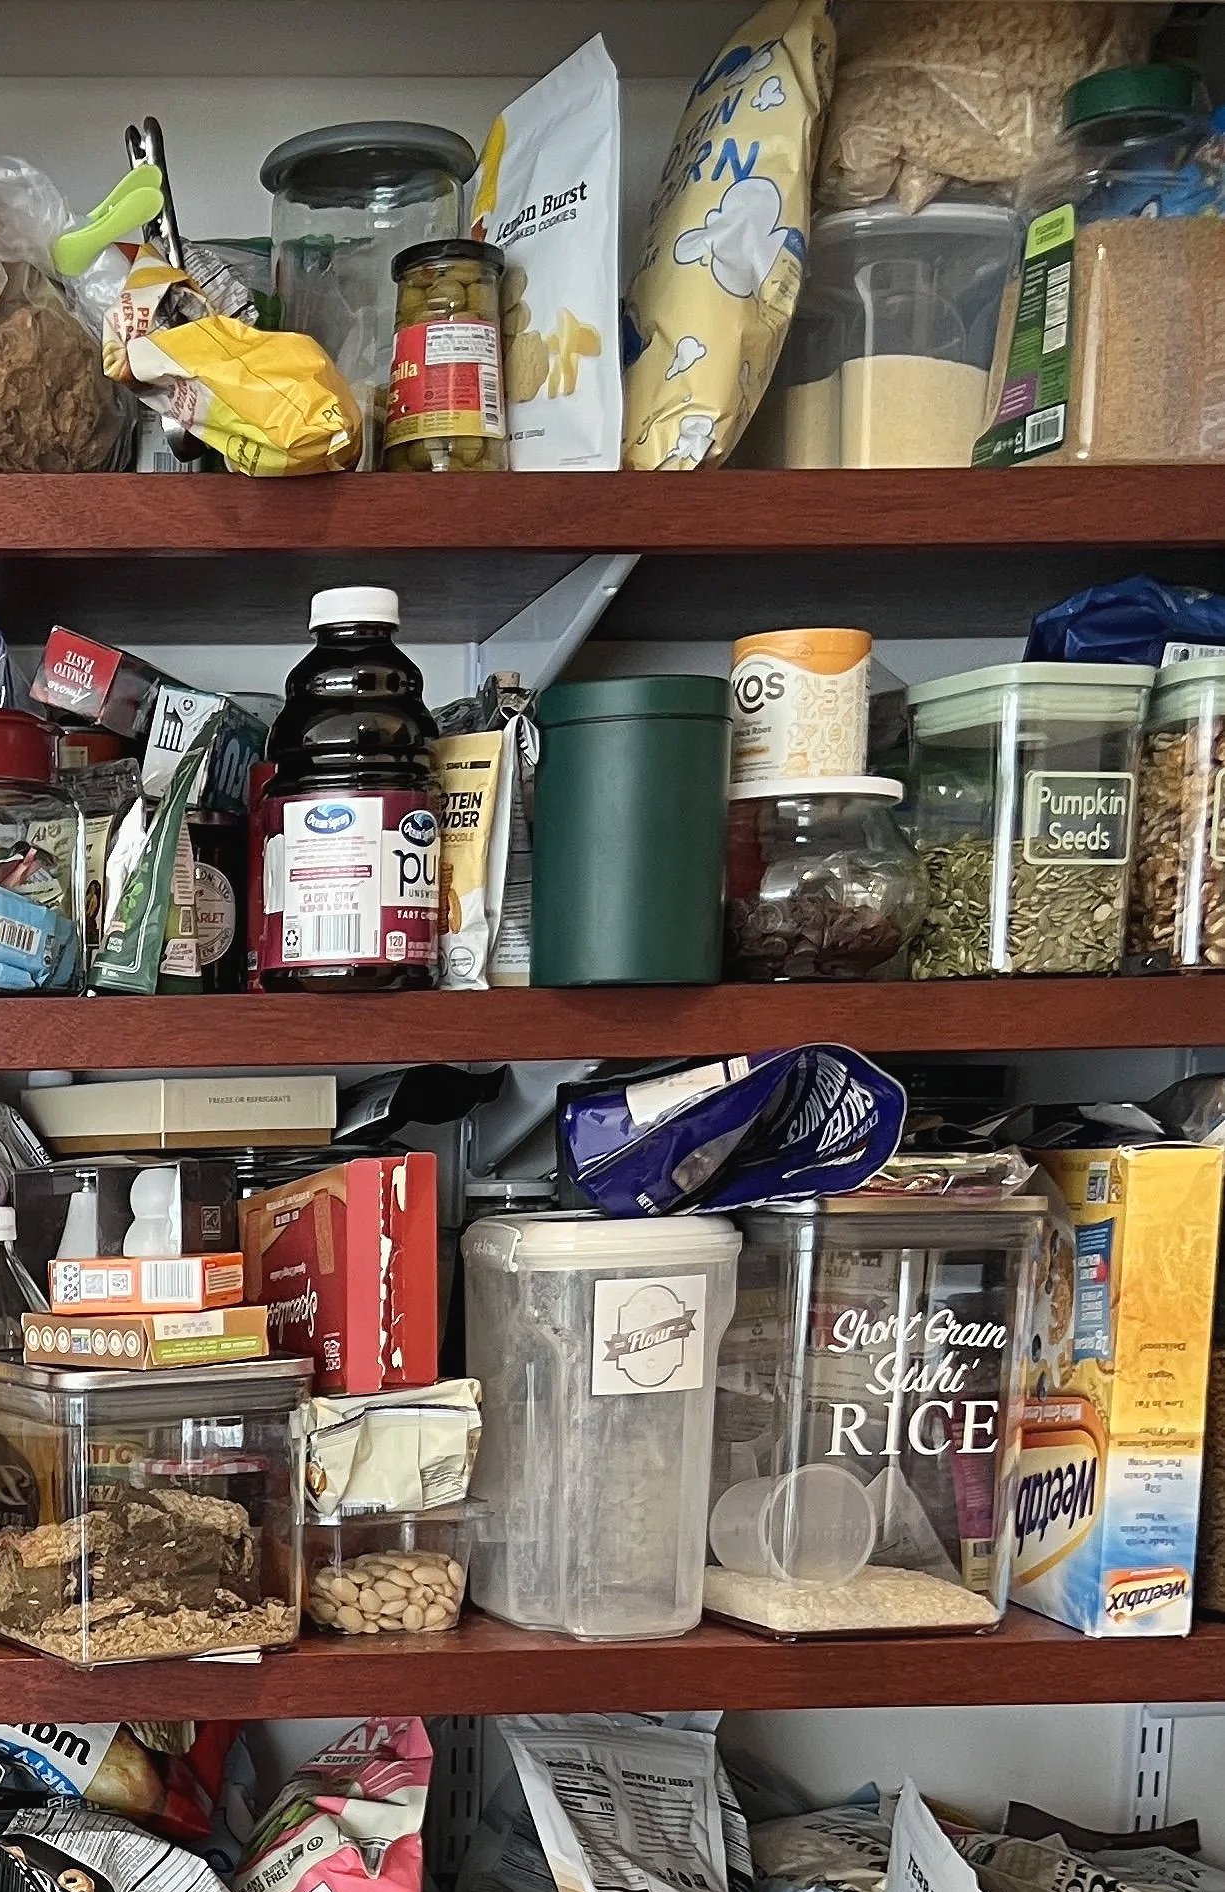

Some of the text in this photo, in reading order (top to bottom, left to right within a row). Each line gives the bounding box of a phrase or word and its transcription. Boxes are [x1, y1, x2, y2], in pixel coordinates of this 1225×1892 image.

[495, 181, 588, 243] Lemon Burst
[65, 649, 95, 673] PASTE
[53, 662, 94, 690] TOMATO
[1037, 786, 1127, 821] Pumpkin
[1047, 822, 1111, 852] Seeds
[397, 909, 419, 919] TART
[627, 1327, 676, 1353] Flour
[828, 1309, 1008, 1354] Short Grain
[825, 1400, 999, 1456] RICE
[1124, 1472, 1183, 1481] Whole Grain
[1128, 1458, 1164, 1468] Serving
[1120, 1525, 1180, 1534] Whole Grain
[1147, 1537, 1176, 1547] Made
[1107, 1579, 1187, 1614] Weetabix
